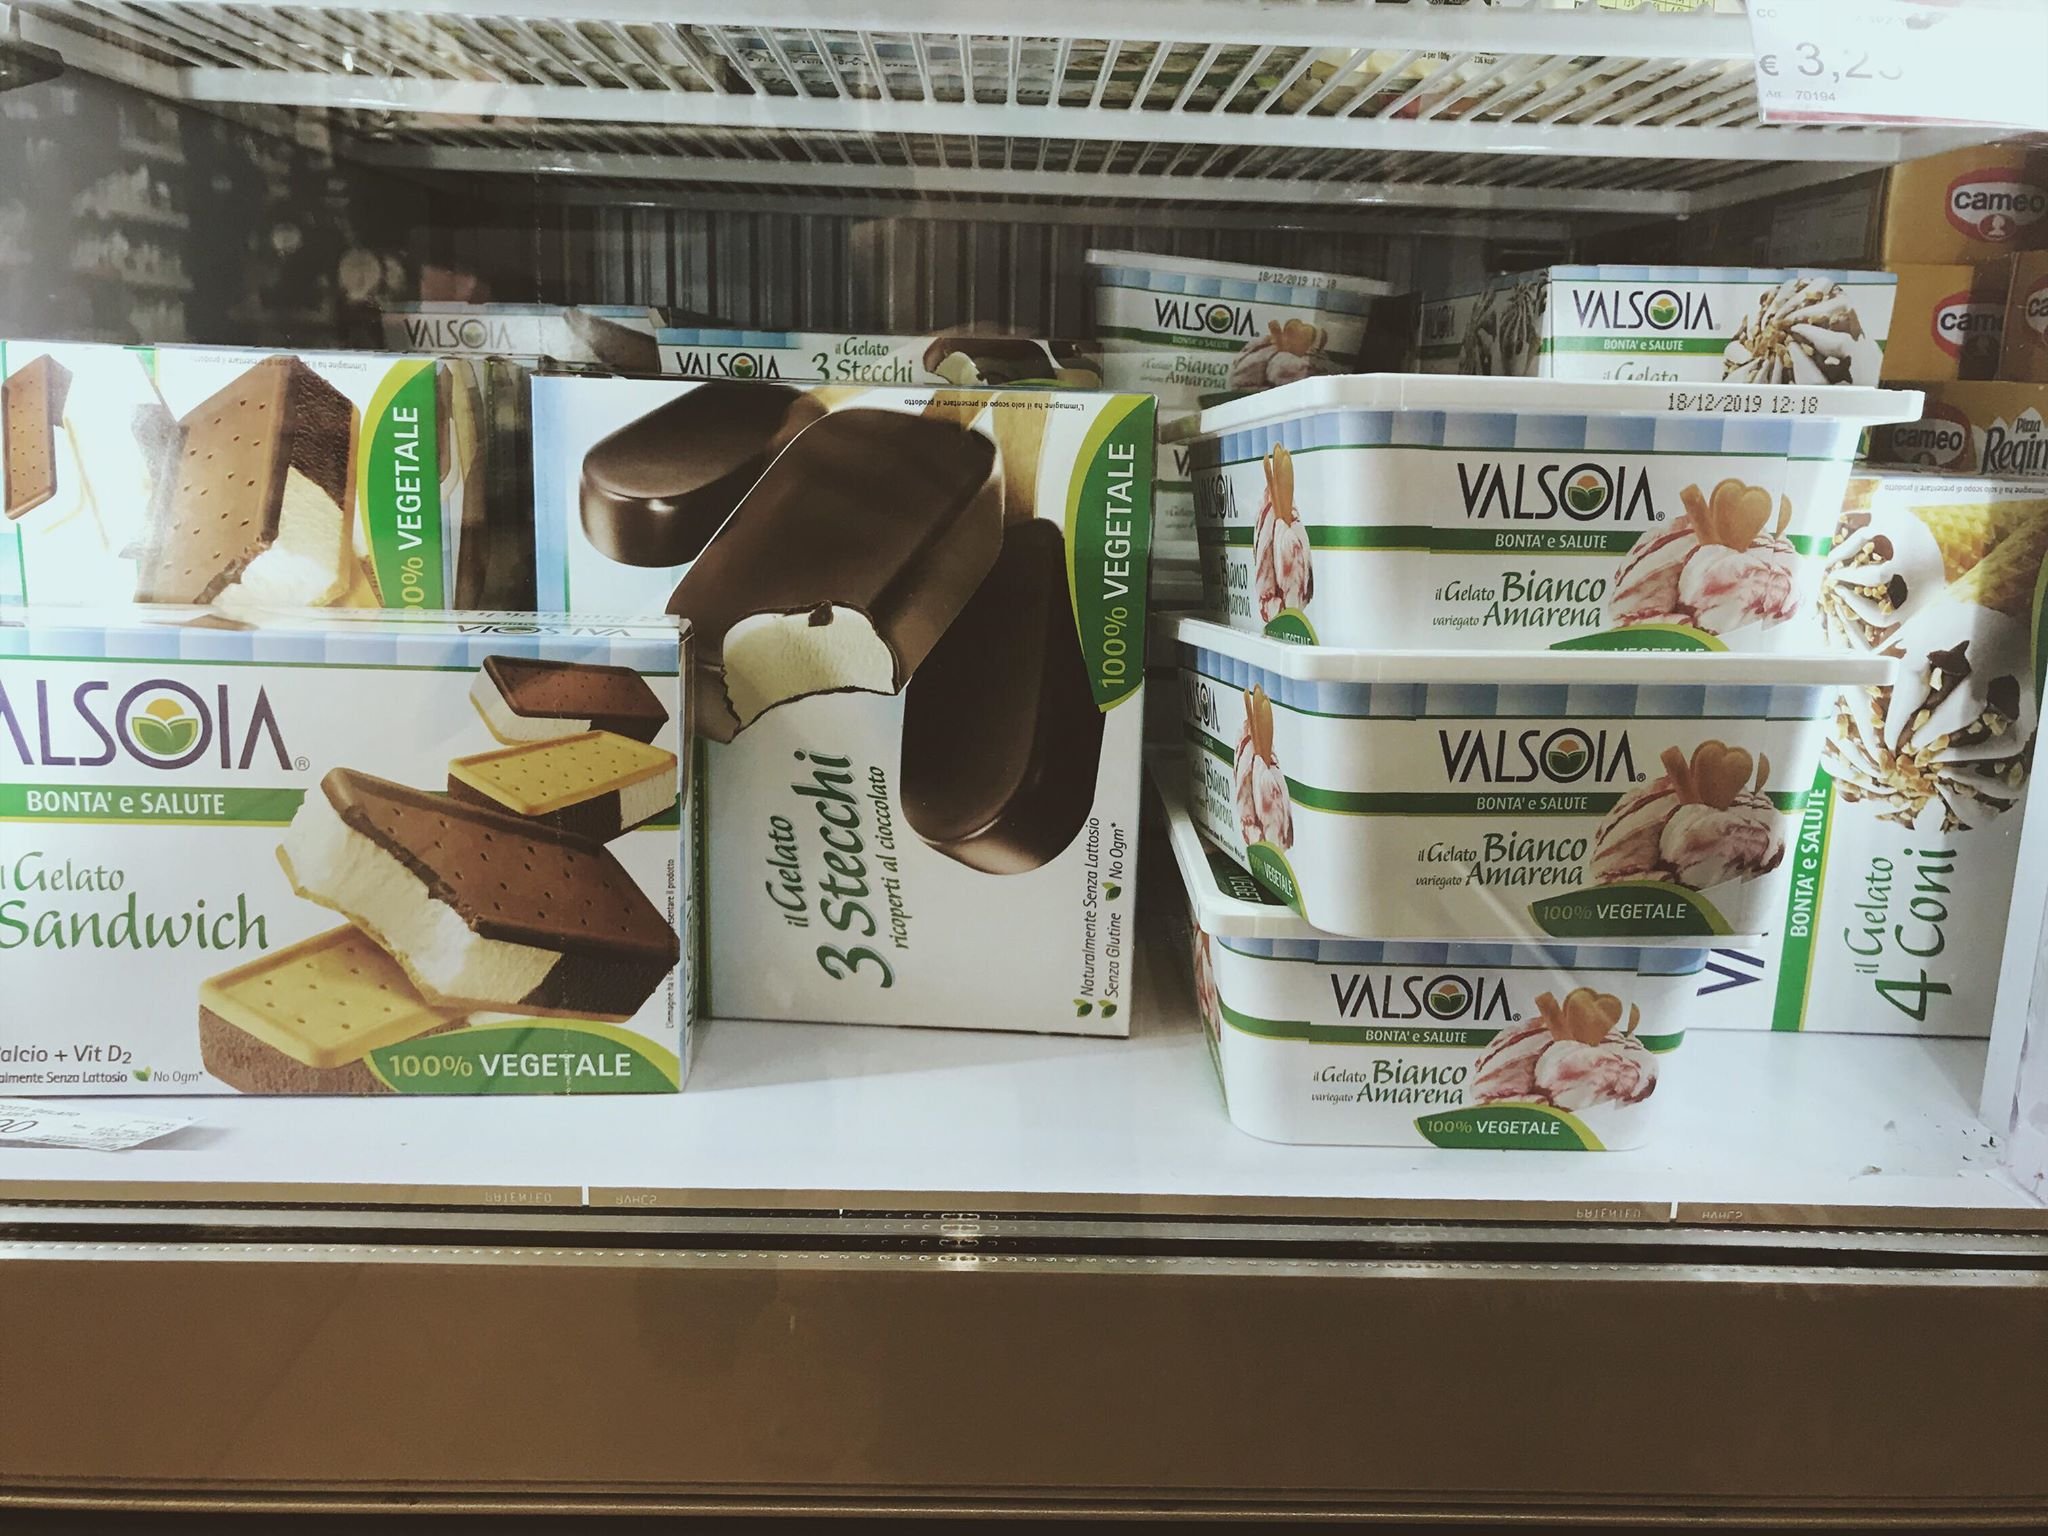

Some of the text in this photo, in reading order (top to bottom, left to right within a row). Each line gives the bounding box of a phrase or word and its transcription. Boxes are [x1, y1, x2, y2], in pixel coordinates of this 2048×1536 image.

[1759, 54, 1779, 76] €
[1954, 190, 2046, 212] cameo
[1155, 298, 1255, 337] VALSOIA
[1572, 289, 1714, 331] VALSOIA
[404, 318, 512, 349] VALSOIA
[843, 337, 889, 356] Gelato
[1604, 339, 1683, 352] BONTA' e SALUTE
[812, 353, 912, 383] 3 Stecchi
[1165, 371, 1227, 389] Amarena
[1175, 355, 1229, 376] Bianco
[1668, 393, 1818, 414] 18/12/2019 12:18
[1895, 427, 1963, 450] cameo
[1457, 462, 1655, 521] VALSOIA
[393, 407, 425, 609] 0% VEGETALE
[1495, 533, 1607, 549] BONTA' e SALUTE
[1098, 443, 1135, 688] 100% VEGETALE
[1435, 569, 1606, 603] il Gelato Bianco
[1432, 601, 1601, 630] variegato Amarena
[1438, 727, 1636, 783] VALSOIA
[26, 790, 225, 815] BONTA' e SALUTE
[1476, 797, 1588, 810] BONTA' e SALUTE
[866, 766, 912, 949] ricoperti al cioccolato
[1417, 831, 1588, 863] il Gelato Bianco
[14, 851, 125, 891] Gelato
[766, 815, 808, 927] il Gelato
[790, 749, 894, 989] 3 Stecchi
[1109, 862, 1123, 880] No
[1415, 861, 1583, 890] variegato Amarena
[1790, 788, 1827, 937] BONTA' e SALUTE
[0, 891, 268, 950] Sandwich
[1080, 817, 1100, 996] Naturalmente Senza Lattosio
[1542, 903, 1686, 920] 100% VEGETALE
[1844, 856, 1894, 973] il Gelato
[1875, 848, 1957, 1022] 4 Coni
[1105, 912, 1122, 998] Senza Glutine
[1330, 973, 1512, 1021] VALSOIA
[1365, 1030, 1467, 1044] BONTA' e SALUTE
[0, 1045, 48, 1062] alcio
[54, 1050, 68, 1062] +
[74, 1045, 101, 1062] Vit
[388, 1053, 632, 1078] 100% VEGETALE
[46, 1071, 80, 1084] Senza
[83, 1071, 128, 1084] Lattosio
[154, 1071, 169, 1082] No
[1313, 1058, 1467, 1085] il Gelato Bianco
[1311, 1082, 1464, 1106] variegato Amarena
[1427, 1120, 1560, 1135] 100% VEGETALE
